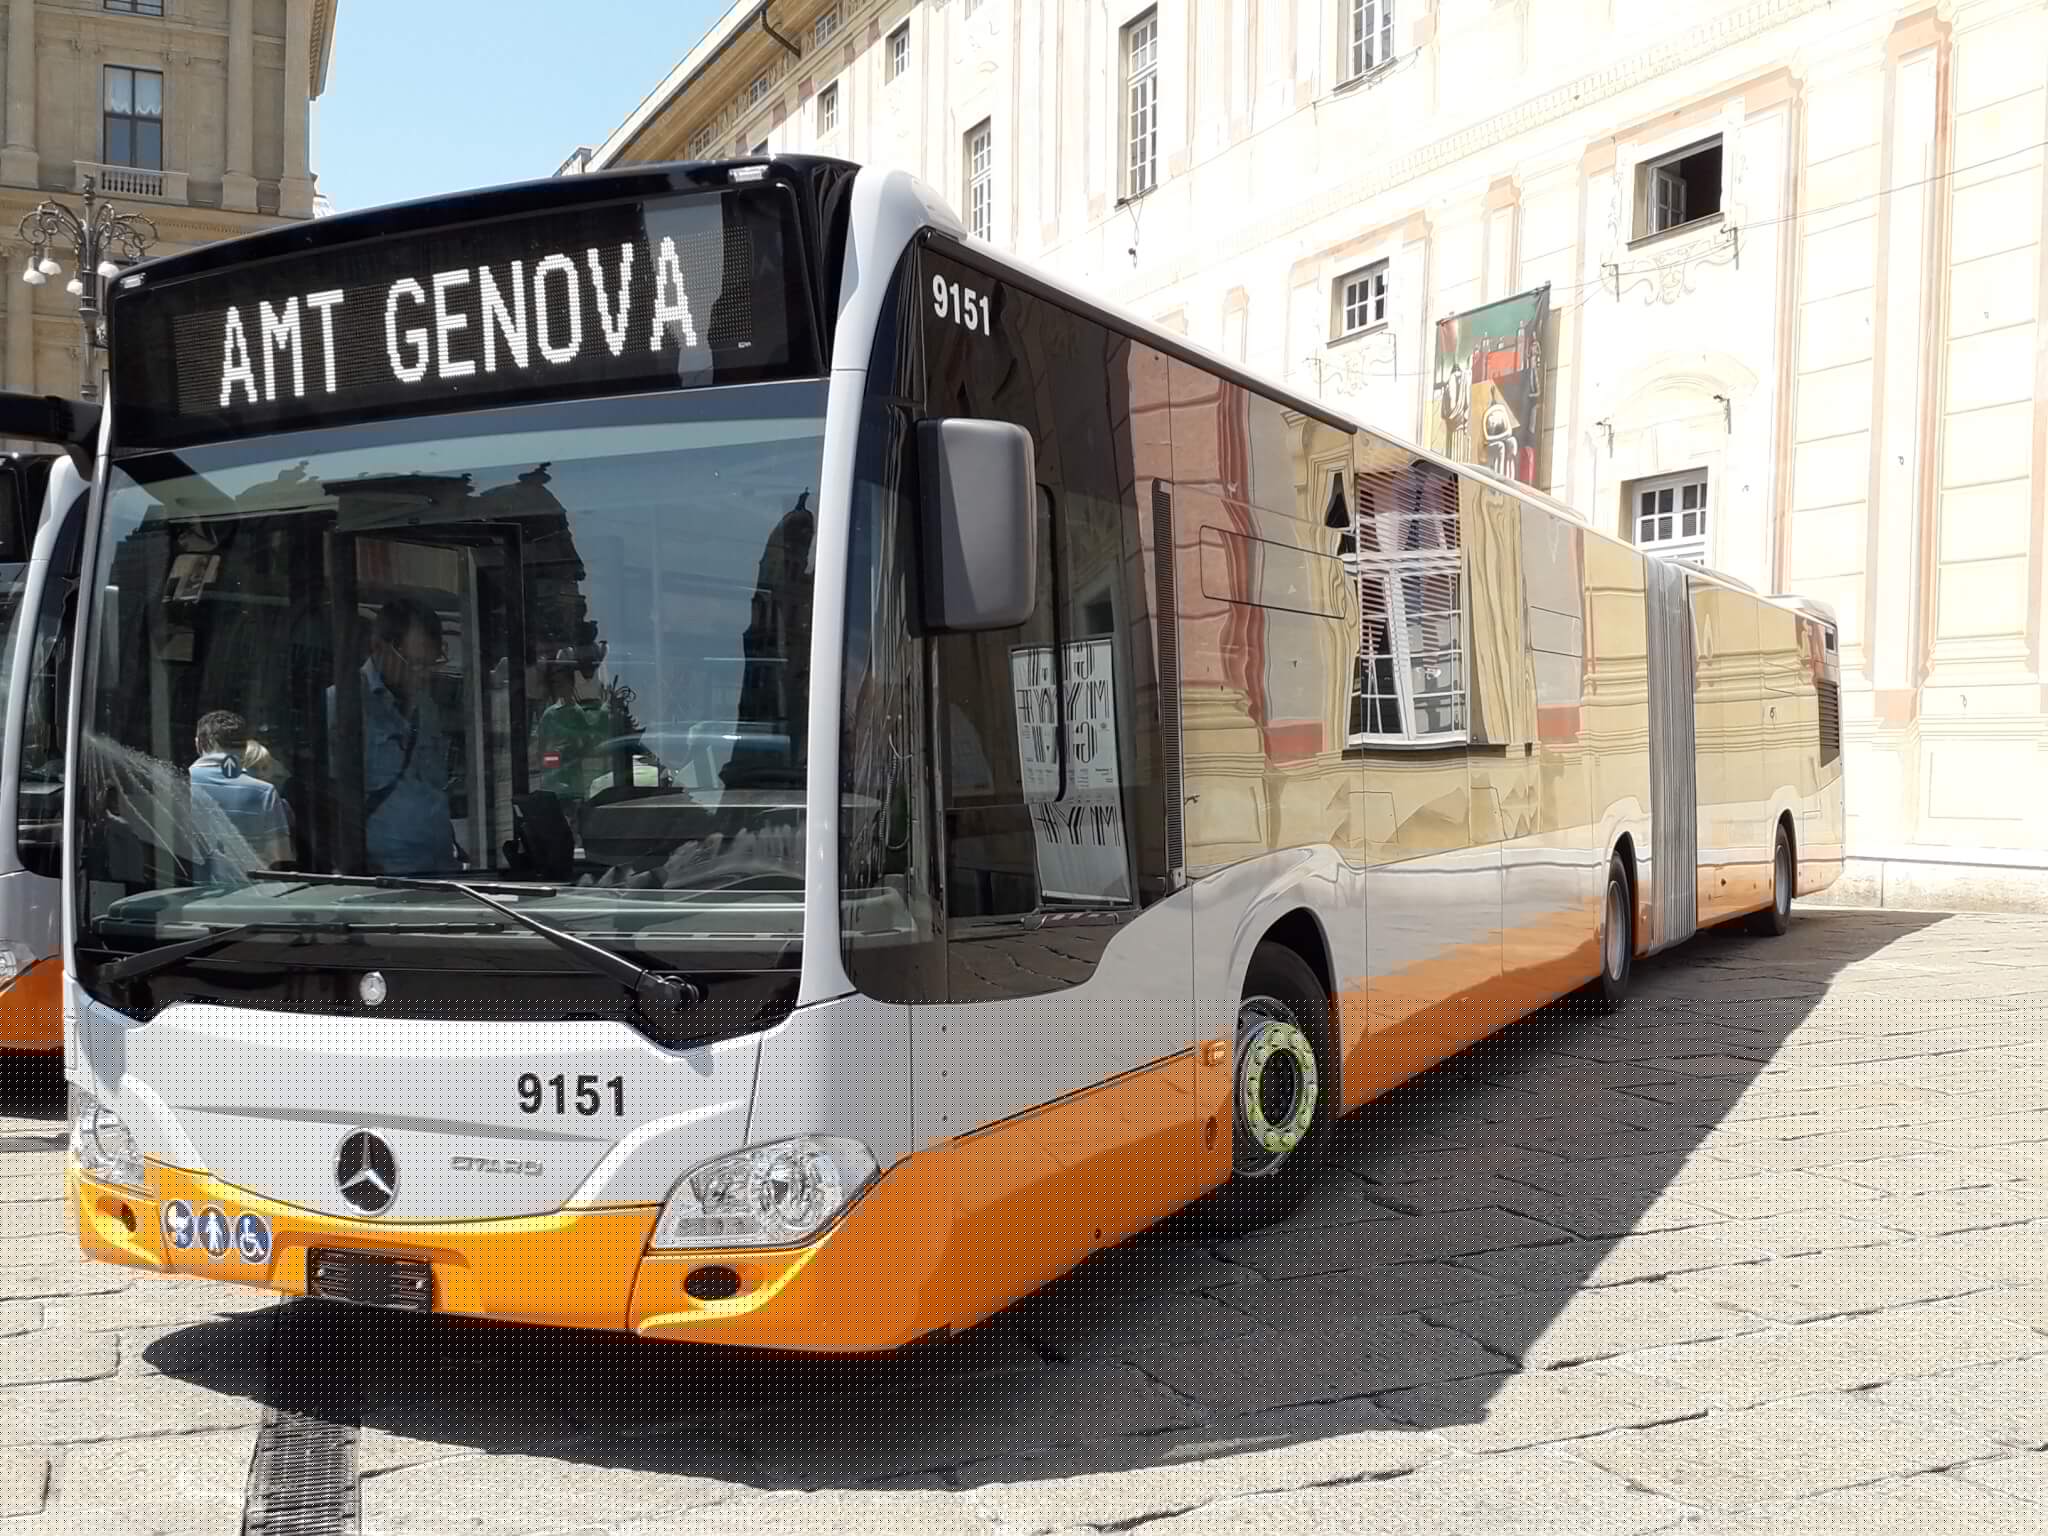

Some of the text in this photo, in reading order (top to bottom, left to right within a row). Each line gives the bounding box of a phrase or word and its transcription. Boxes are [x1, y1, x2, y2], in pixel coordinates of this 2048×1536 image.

[219, 236, 697, 407] AMT GENOVA
[932, 274, 990, 337] 9151
[516, 1072, 627, 1117] 9151
